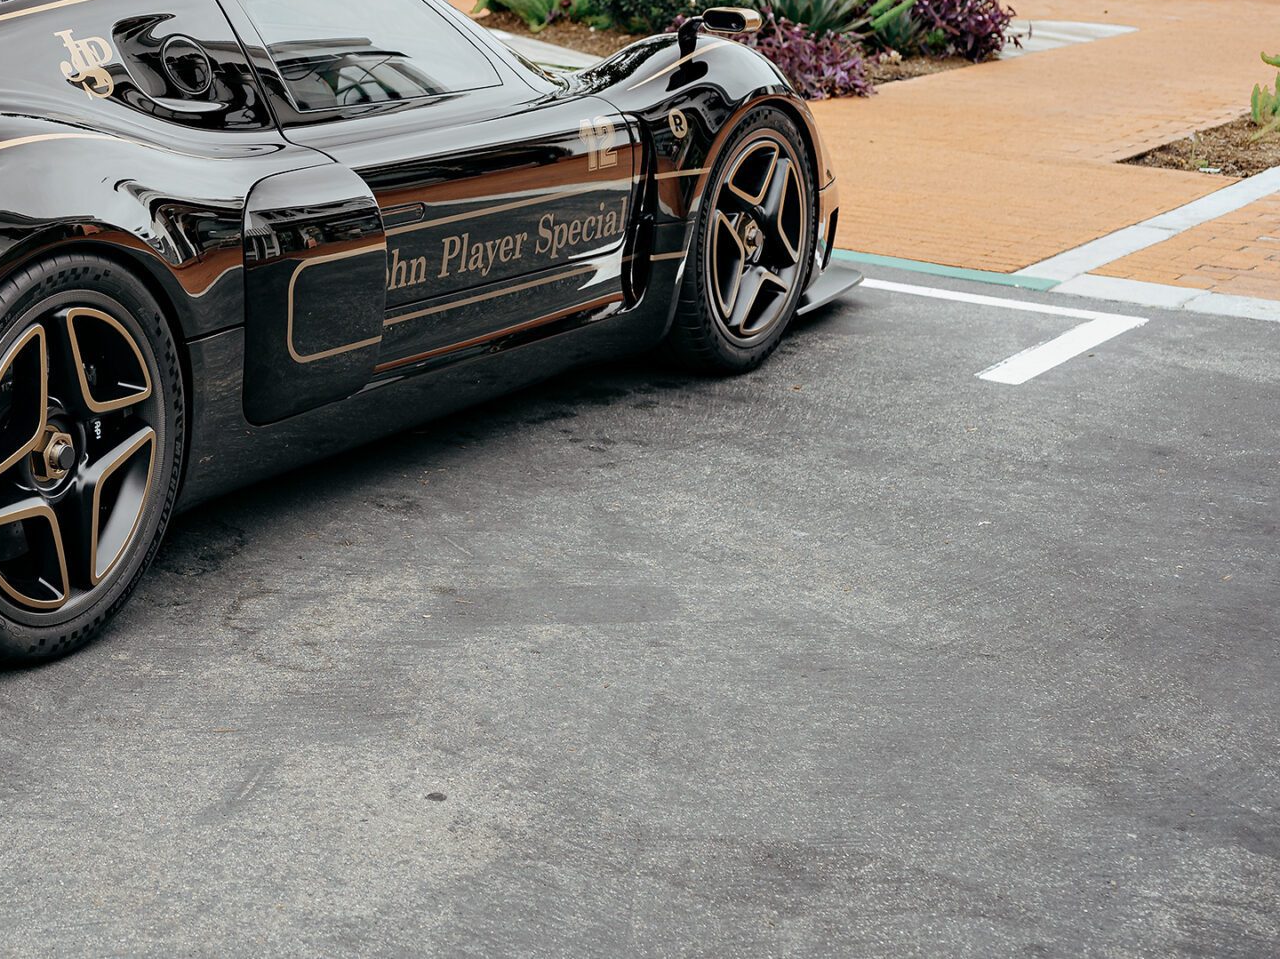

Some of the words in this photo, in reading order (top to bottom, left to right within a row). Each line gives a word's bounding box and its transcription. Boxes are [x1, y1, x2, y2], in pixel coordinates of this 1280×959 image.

[578, 114, 619, 173] 12
[437, 231, 527, 278] Player
[535, 195, 628, 259] Special
[158, 441, 182, 535] MICHELIN
